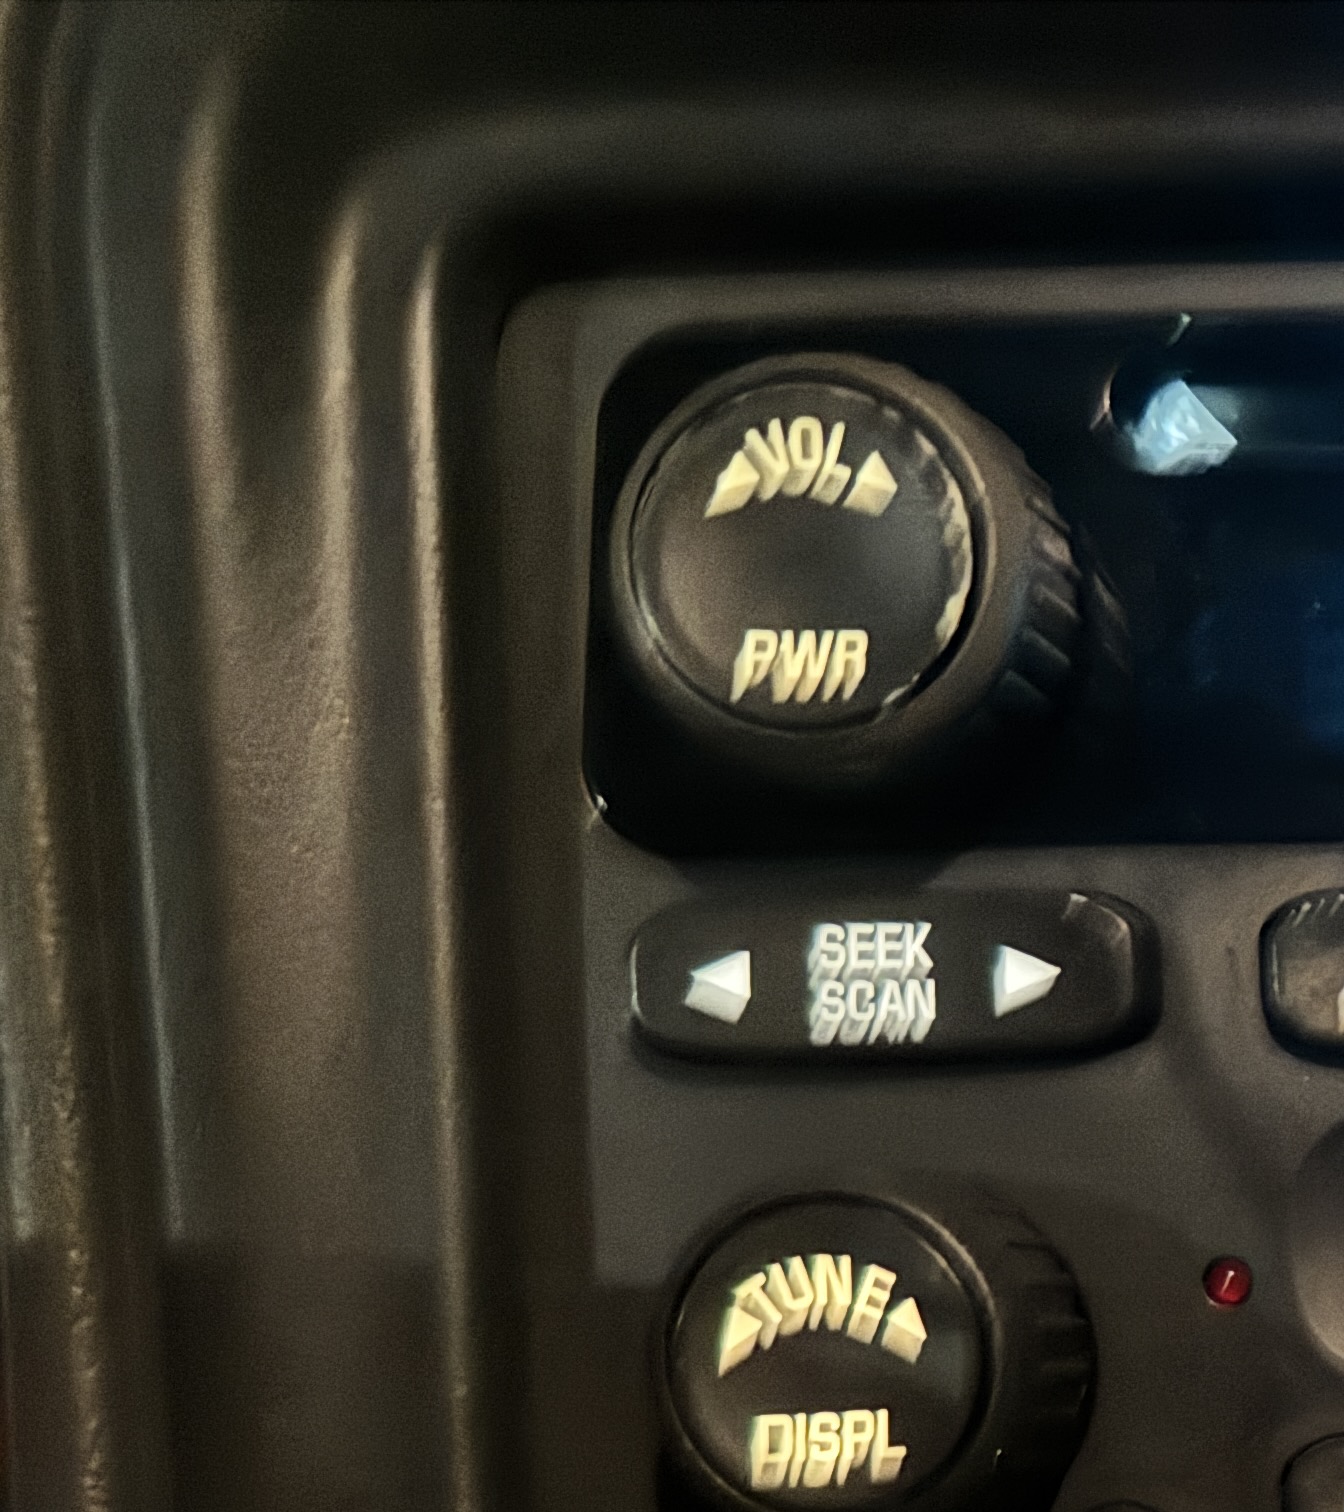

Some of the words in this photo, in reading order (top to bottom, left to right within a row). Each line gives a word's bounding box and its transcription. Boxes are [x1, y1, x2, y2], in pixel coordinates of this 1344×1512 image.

[745, 416, 852, 506] VOL
[730, 629, 868, 704] PWR
[809, 922, 934, 986] SEEK
[808, 978, 936, 1046] SCAN
[733, 1253, 897, 1350] TUNE
[750, 1408, 908, 1491] DISPL
